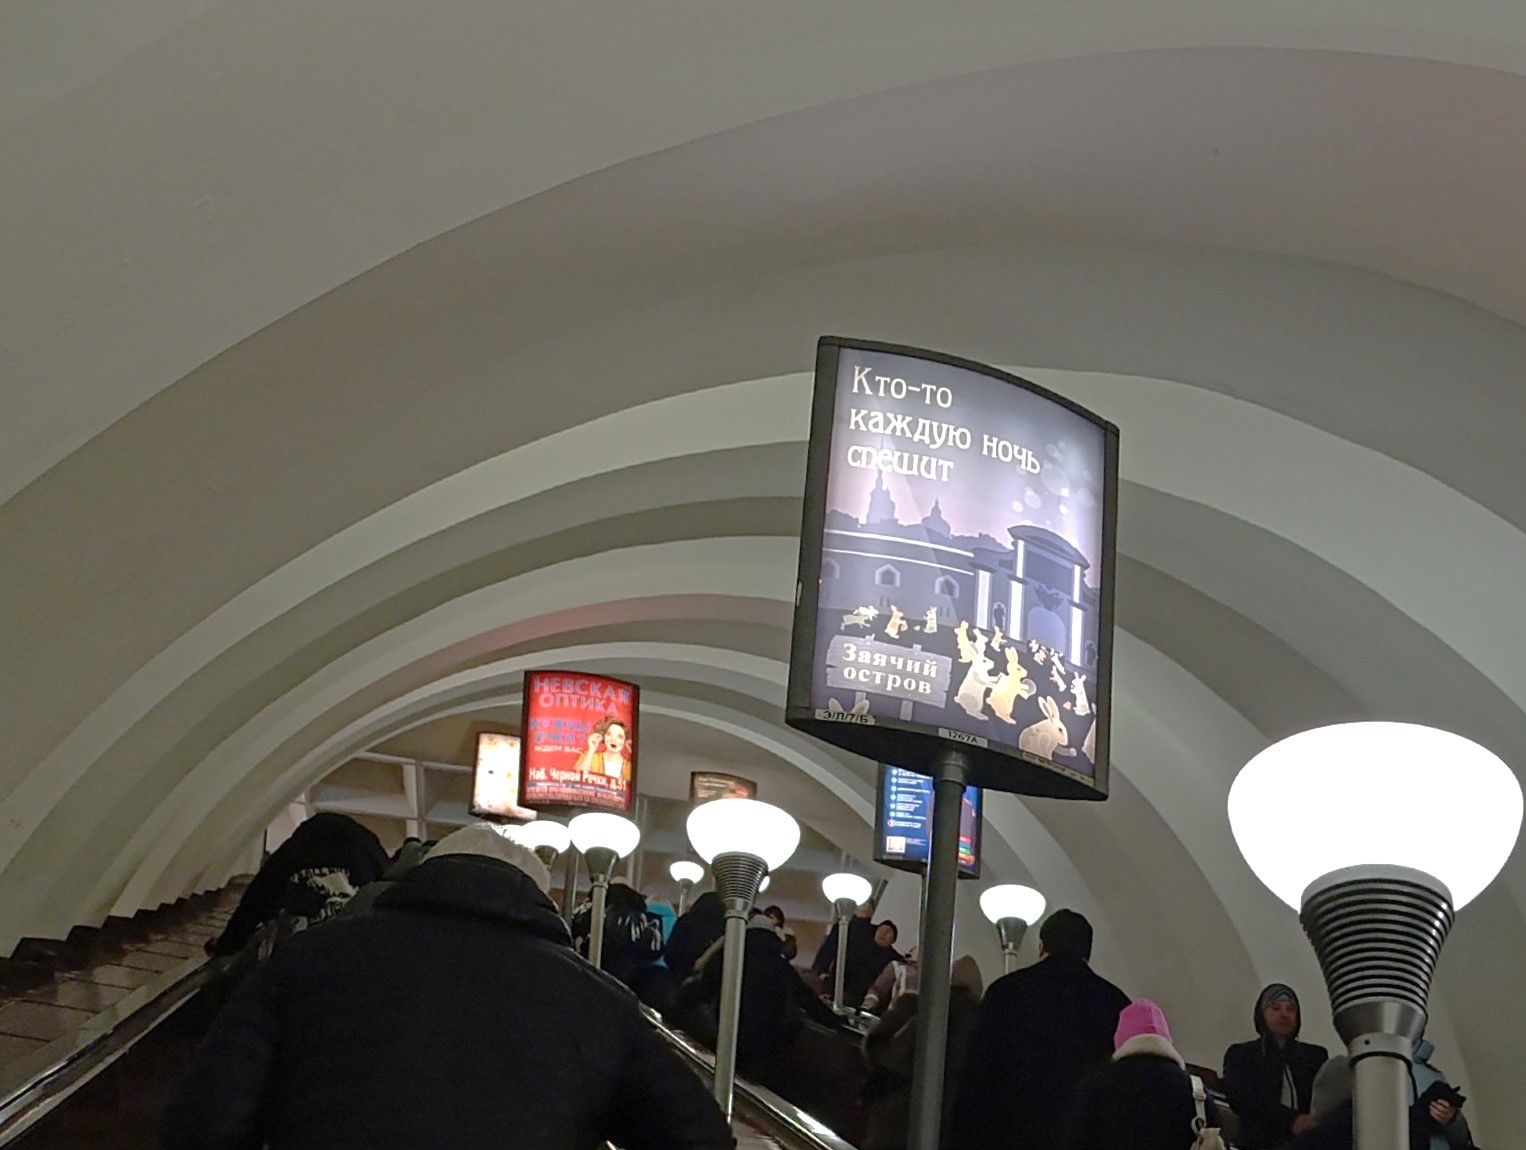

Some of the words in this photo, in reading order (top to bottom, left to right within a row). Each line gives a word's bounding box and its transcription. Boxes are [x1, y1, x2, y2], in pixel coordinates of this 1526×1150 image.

[852, 365, 953, 408] Кто-то
[849, 408, 972, 450] каждую
[982, 433, 1042, 475] ночь
[847, 445, 954, 482] спешит
[841, 643, 938, 678] Заячий
[534, 677, 632, 704] НЕВСКАЯ
[843, 667, 933, 694] остров
[539, 693, 620, 715] ОПТИКА
